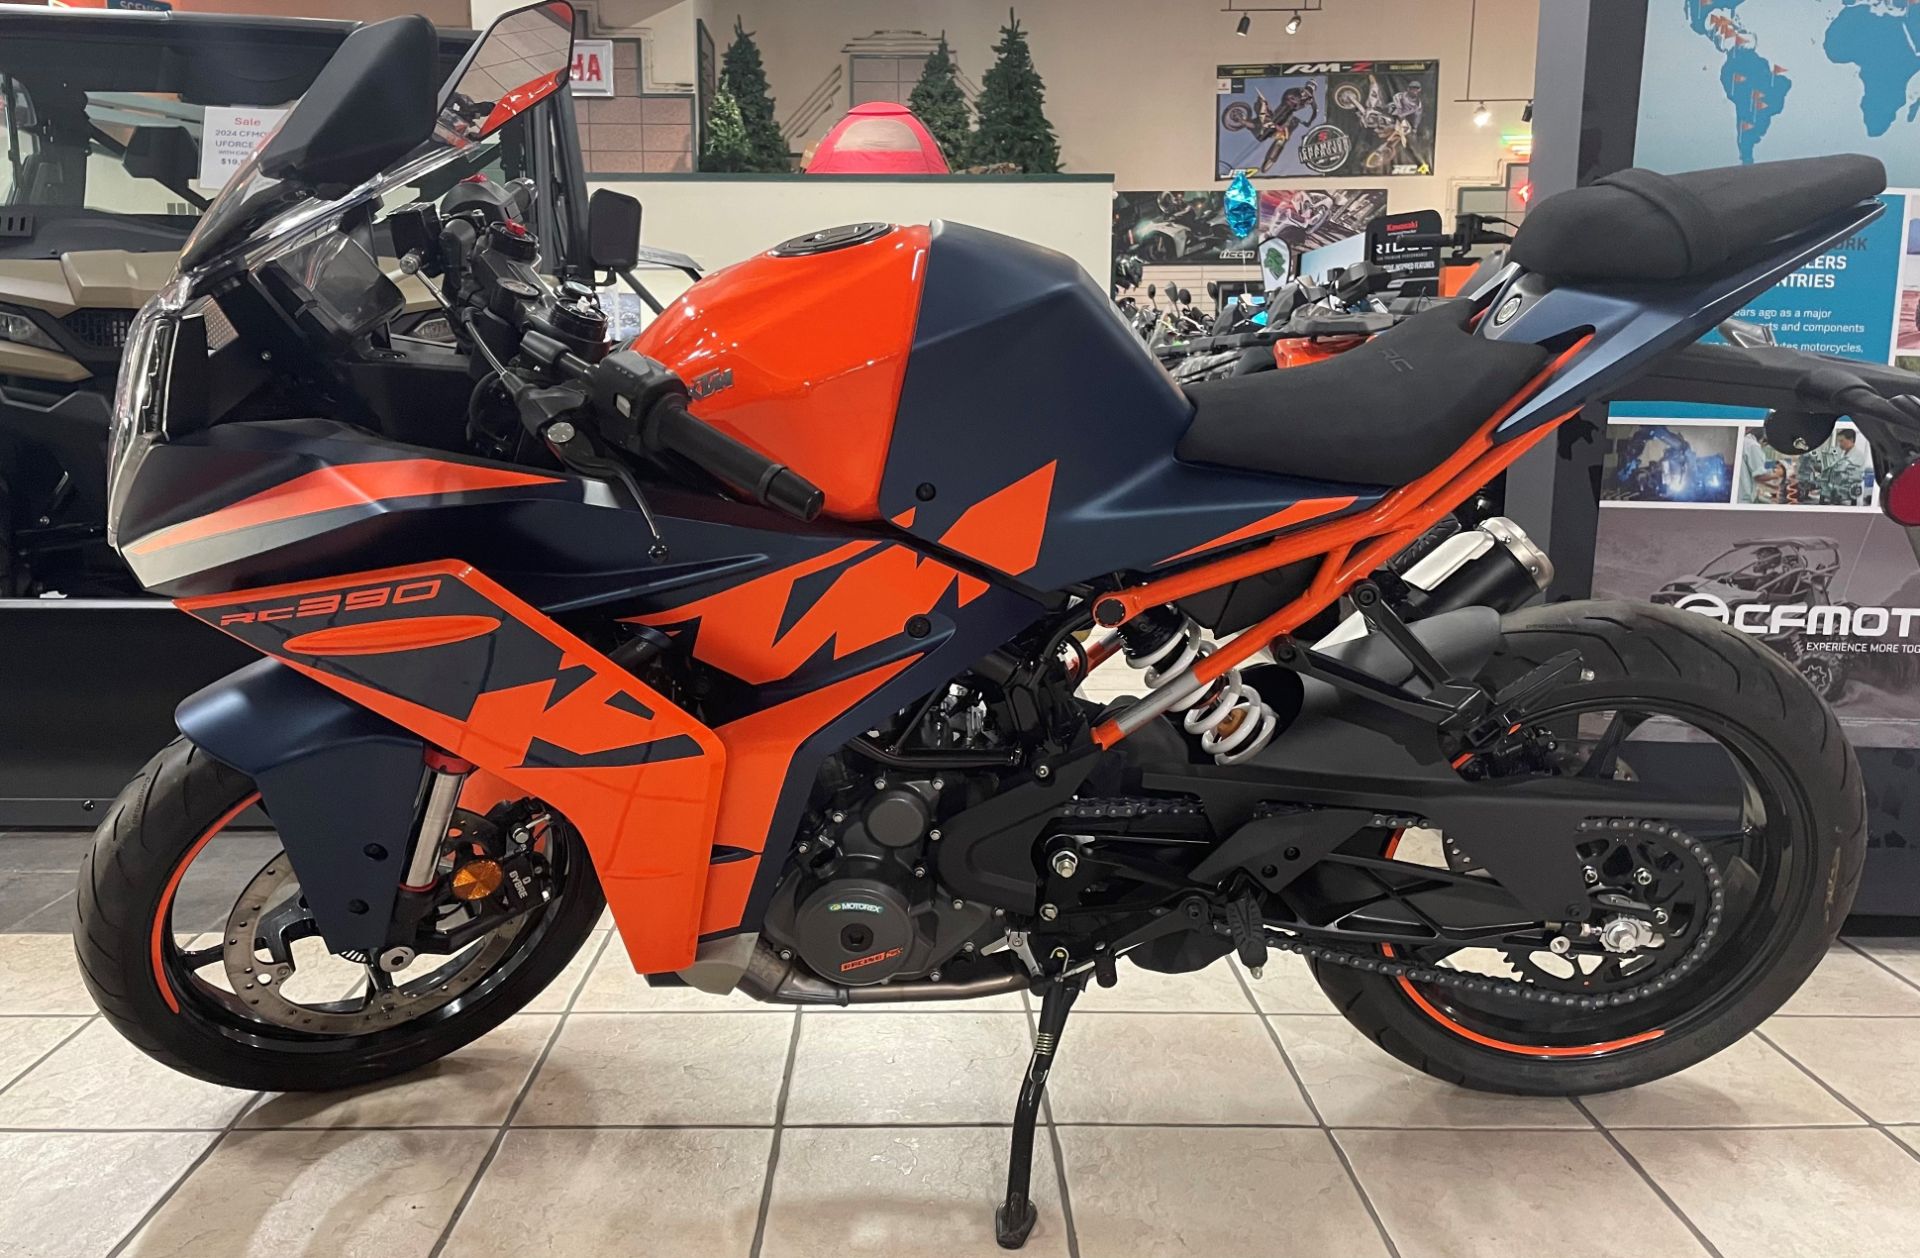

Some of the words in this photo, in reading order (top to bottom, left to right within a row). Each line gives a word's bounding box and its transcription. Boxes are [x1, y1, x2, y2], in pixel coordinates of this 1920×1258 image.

[234, 117, 261, 127] Sale
[215, 129, 237, 137] 2024
[1758, 309, 1777, 319] ago
[1803, 309, 1832, 320] major
[1781, 321, 1800, 331] and
[1802, 322, 1865, 334] components
[1806, 642, 1868, 653] EXPERIENCE
[1869, 643, 1900, 654] MORE
[841, 902, 882, 913] MOTOREX
